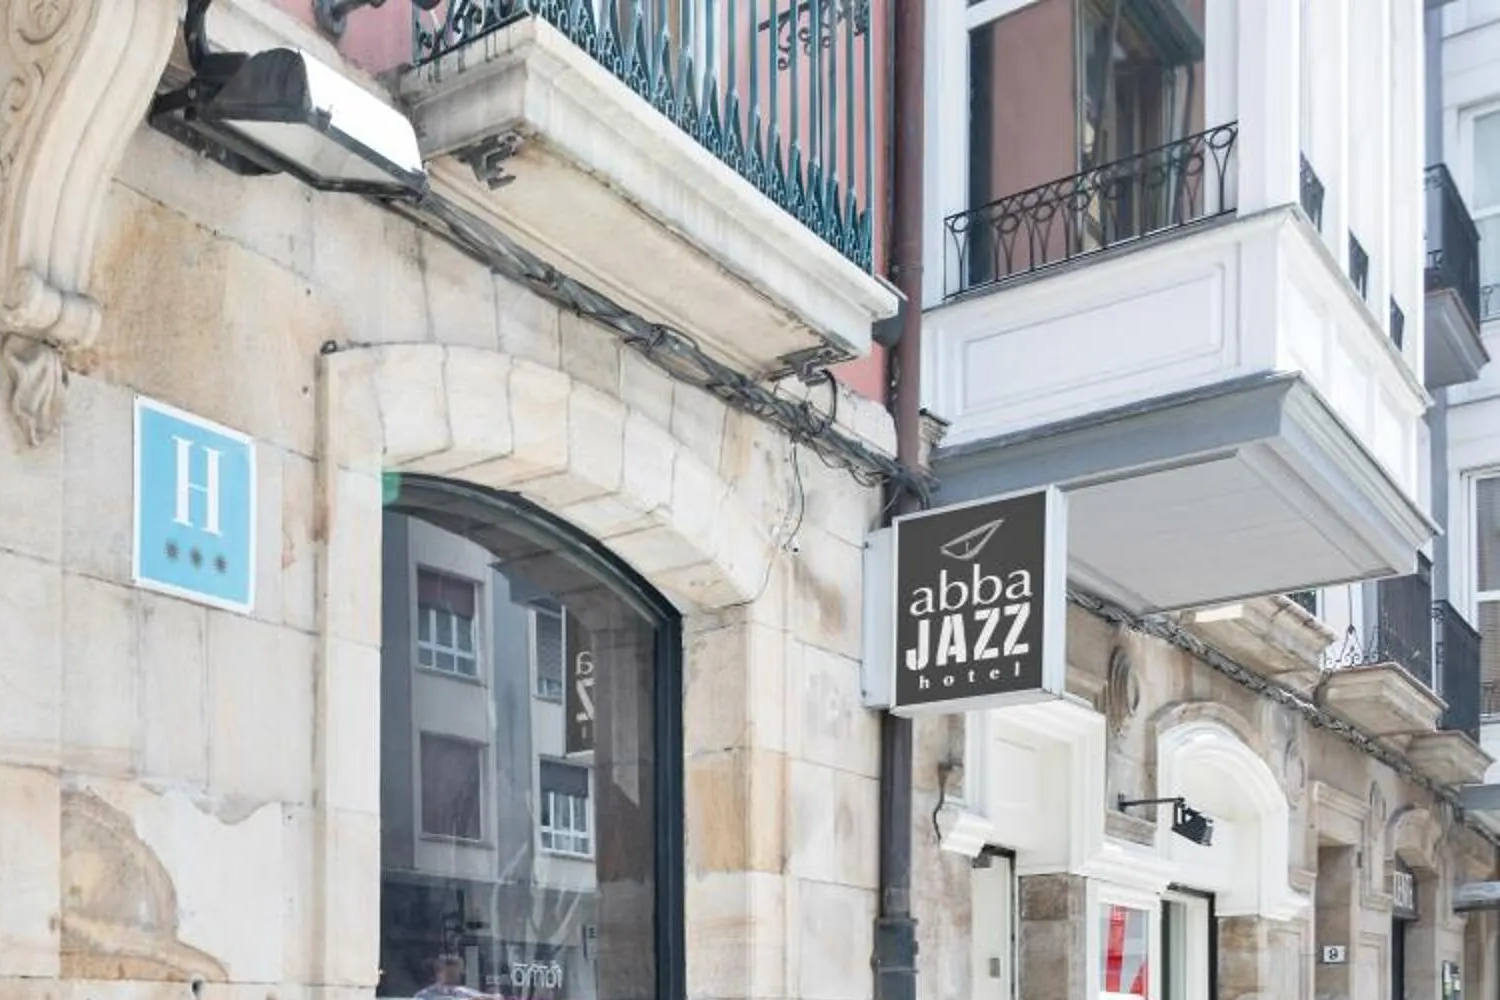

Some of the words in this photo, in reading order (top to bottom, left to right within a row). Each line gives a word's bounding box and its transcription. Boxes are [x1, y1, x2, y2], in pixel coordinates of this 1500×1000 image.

[171, 434, 225, 537] H
[909, 563, 1033, 616] abba
[905, 602, 1031, 671] JAZZ
[918, 662, 1021, 690] hotel
